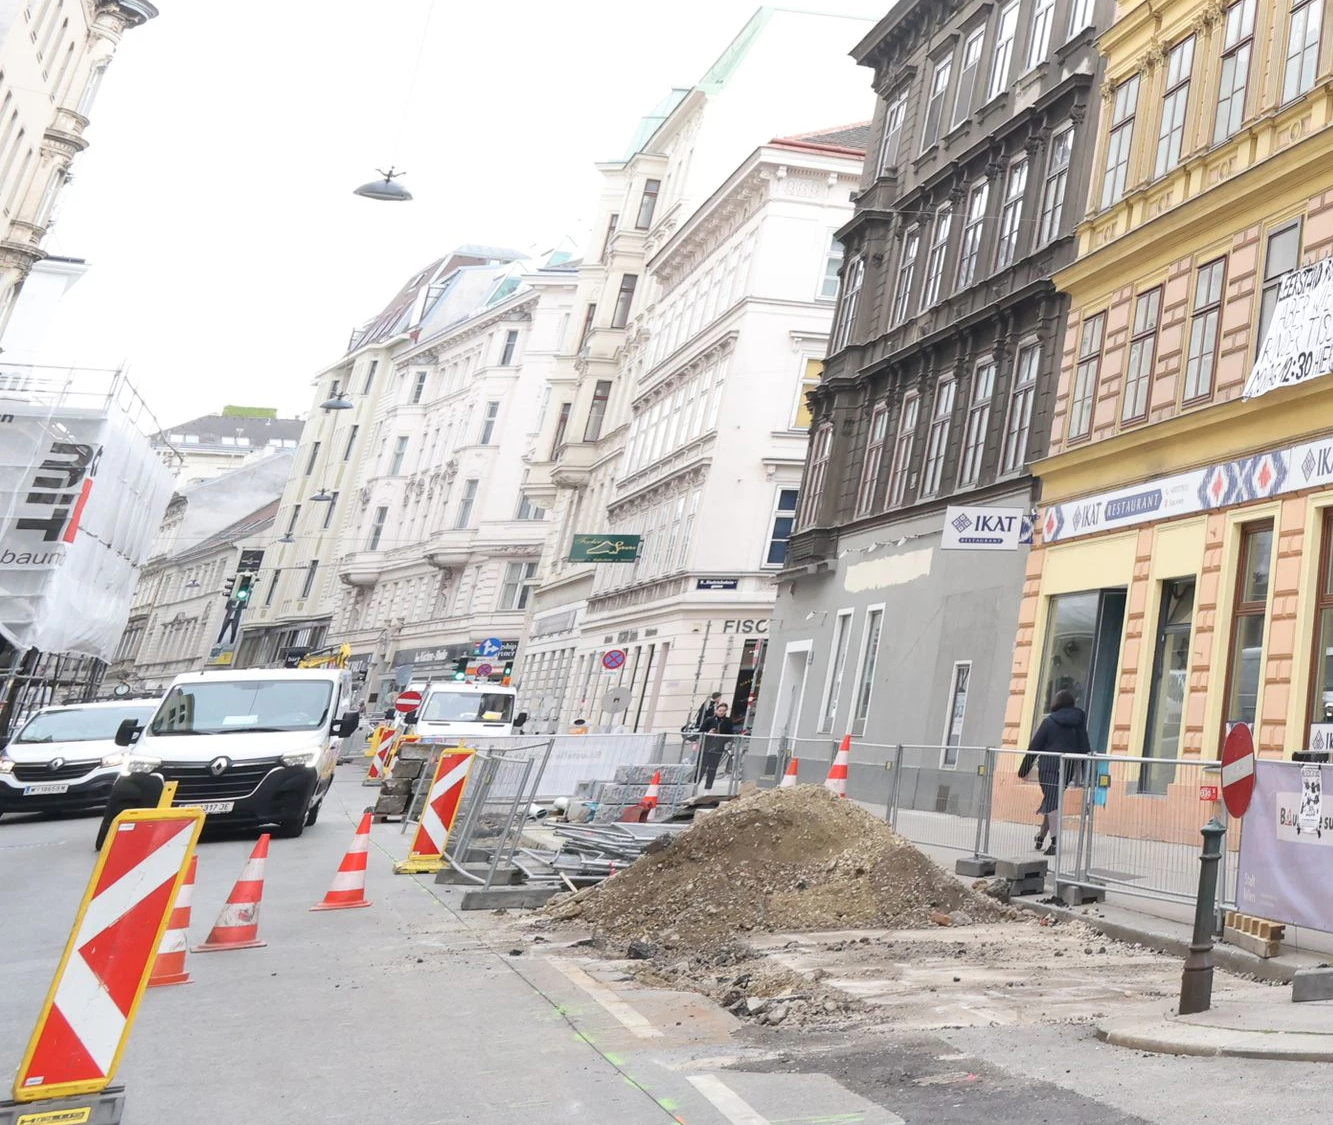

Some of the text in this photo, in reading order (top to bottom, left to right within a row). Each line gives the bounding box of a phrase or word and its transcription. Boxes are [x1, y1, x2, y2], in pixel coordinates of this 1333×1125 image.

[1281, 351, 1313, 383] 12:30
[974, 514, 1017, 533] IKAT
[1081, 492, 1160, 528] IKAT RESTAURANT
